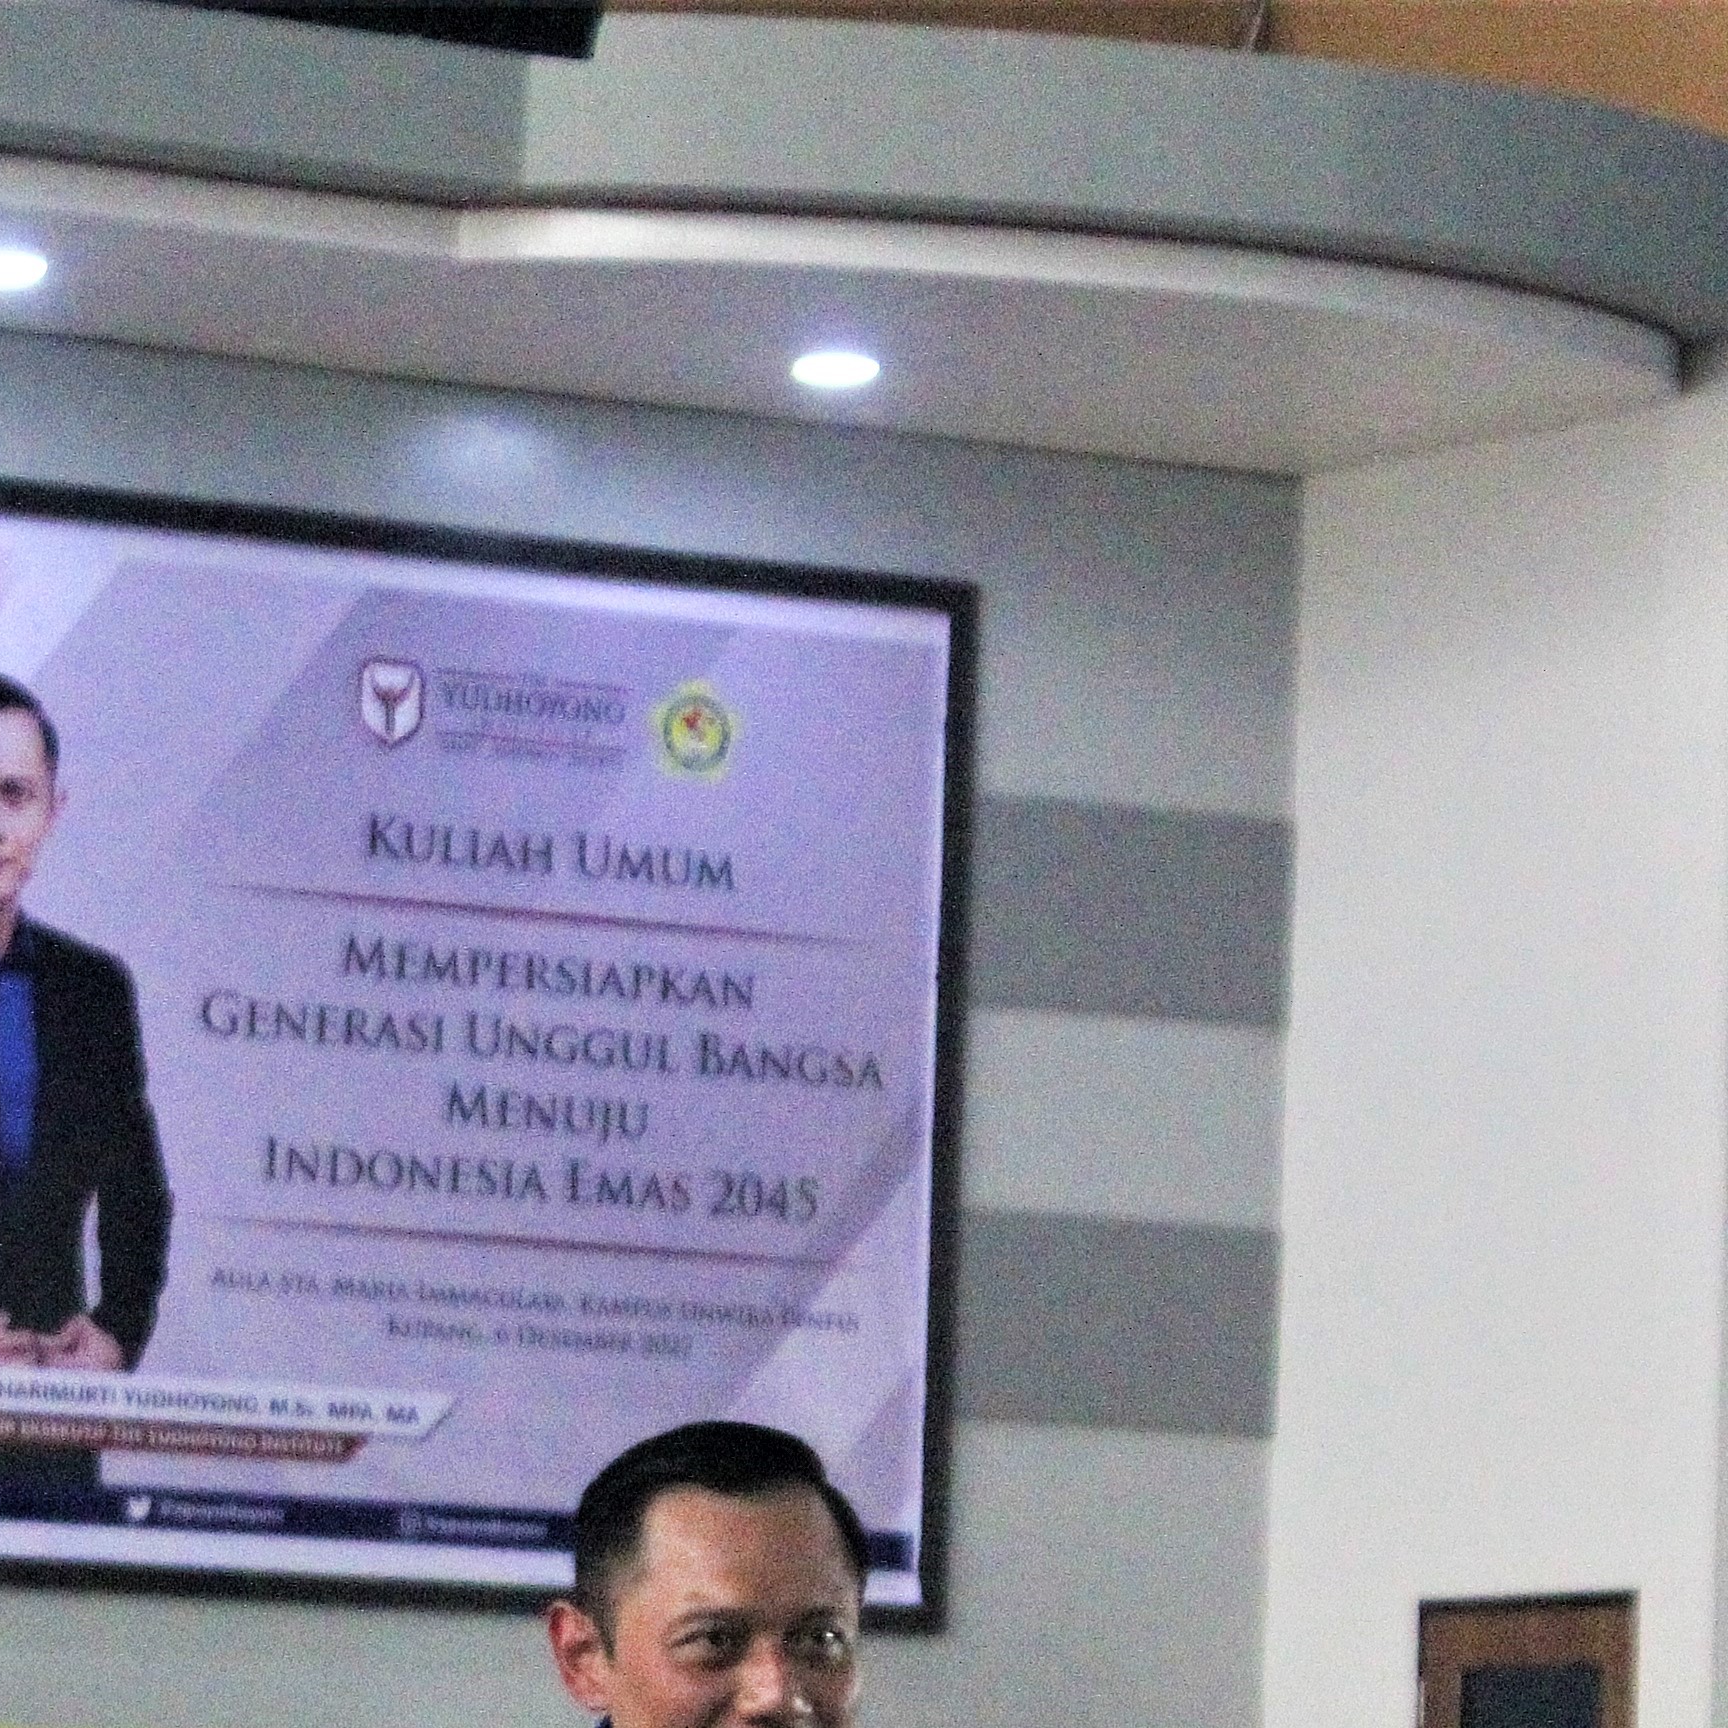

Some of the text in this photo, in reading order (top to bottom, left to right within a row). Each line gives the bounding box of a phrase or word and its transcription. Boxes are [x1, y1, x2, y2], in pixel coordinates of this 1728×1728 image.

[441, 681, 627, 725] YUDHOYONO
[367, 814, 737, 891] KULIAH UMUM
[343, 932, 755, 1009] MEMPERSIAPKAN
[200, 988, 884, 1091] GENERASI UNGGUL BANGSA
[446, 1078, 649, 1144] MENUJU
[263, 1134, 821, 1223] INDONESIA EMAS 2045
[385, 1404, 420, 1424] MA
